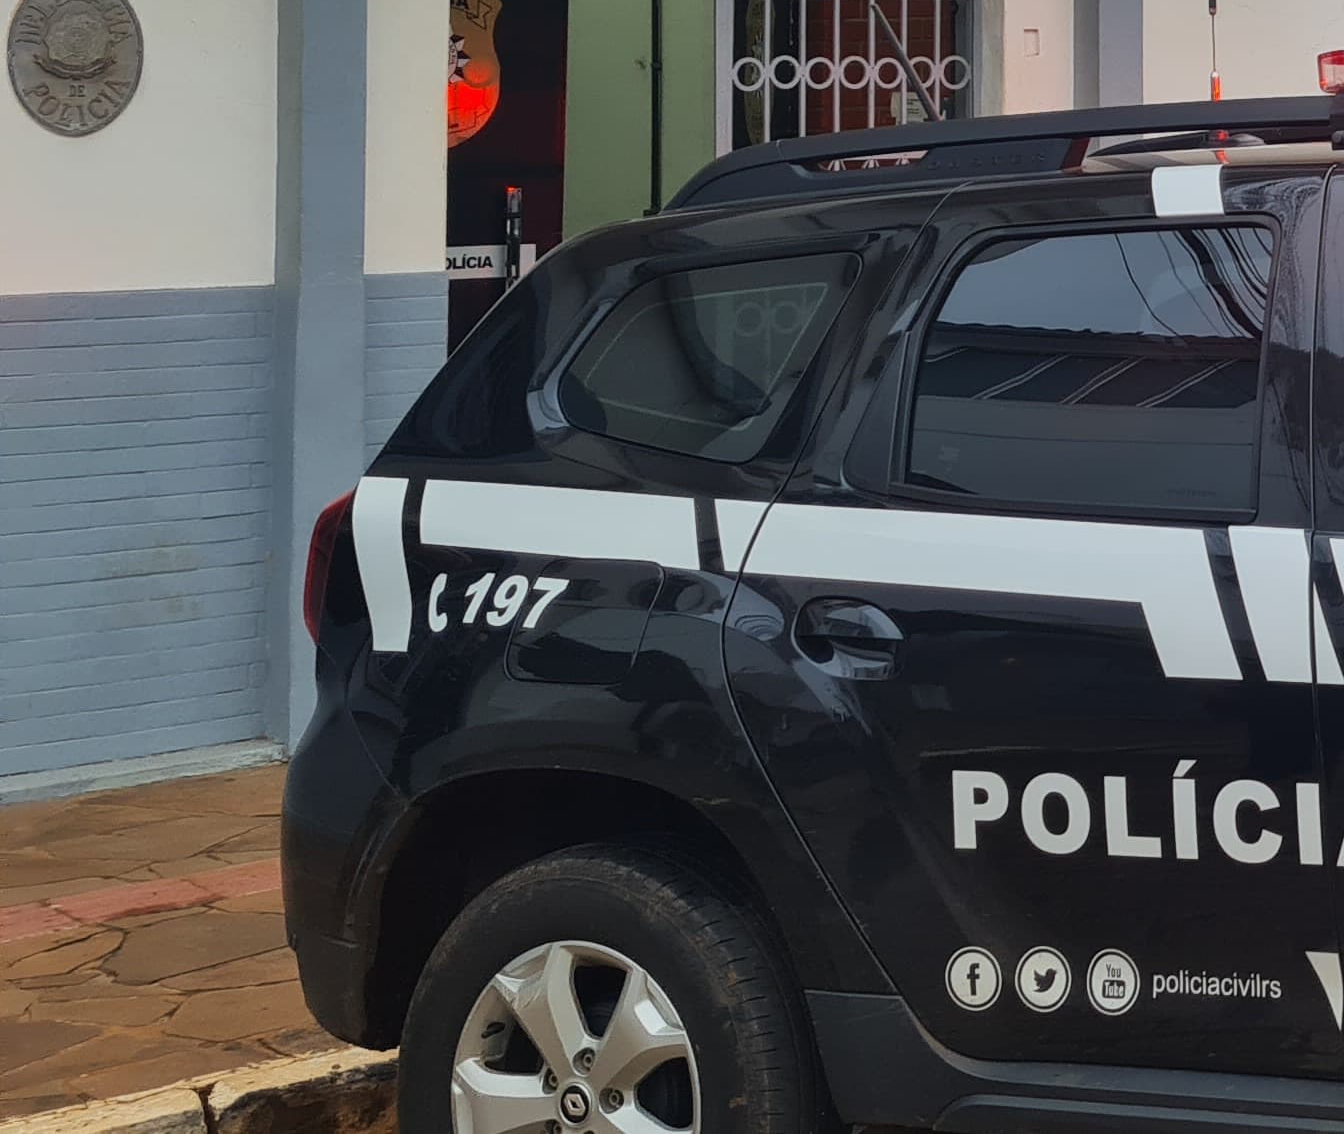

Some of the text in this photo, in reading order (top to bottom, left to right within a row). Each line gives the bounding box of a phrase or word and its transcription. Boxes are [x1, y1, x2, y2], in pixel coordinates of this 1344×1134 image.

[69, 85, 86, 98] DE
[462, 572, 570, 629] 197
[1106, 963, 1122, 978] You
[1105, 981, 1125, 997] Tube
[1152, 970, 1282, 999] policiacivilrs
